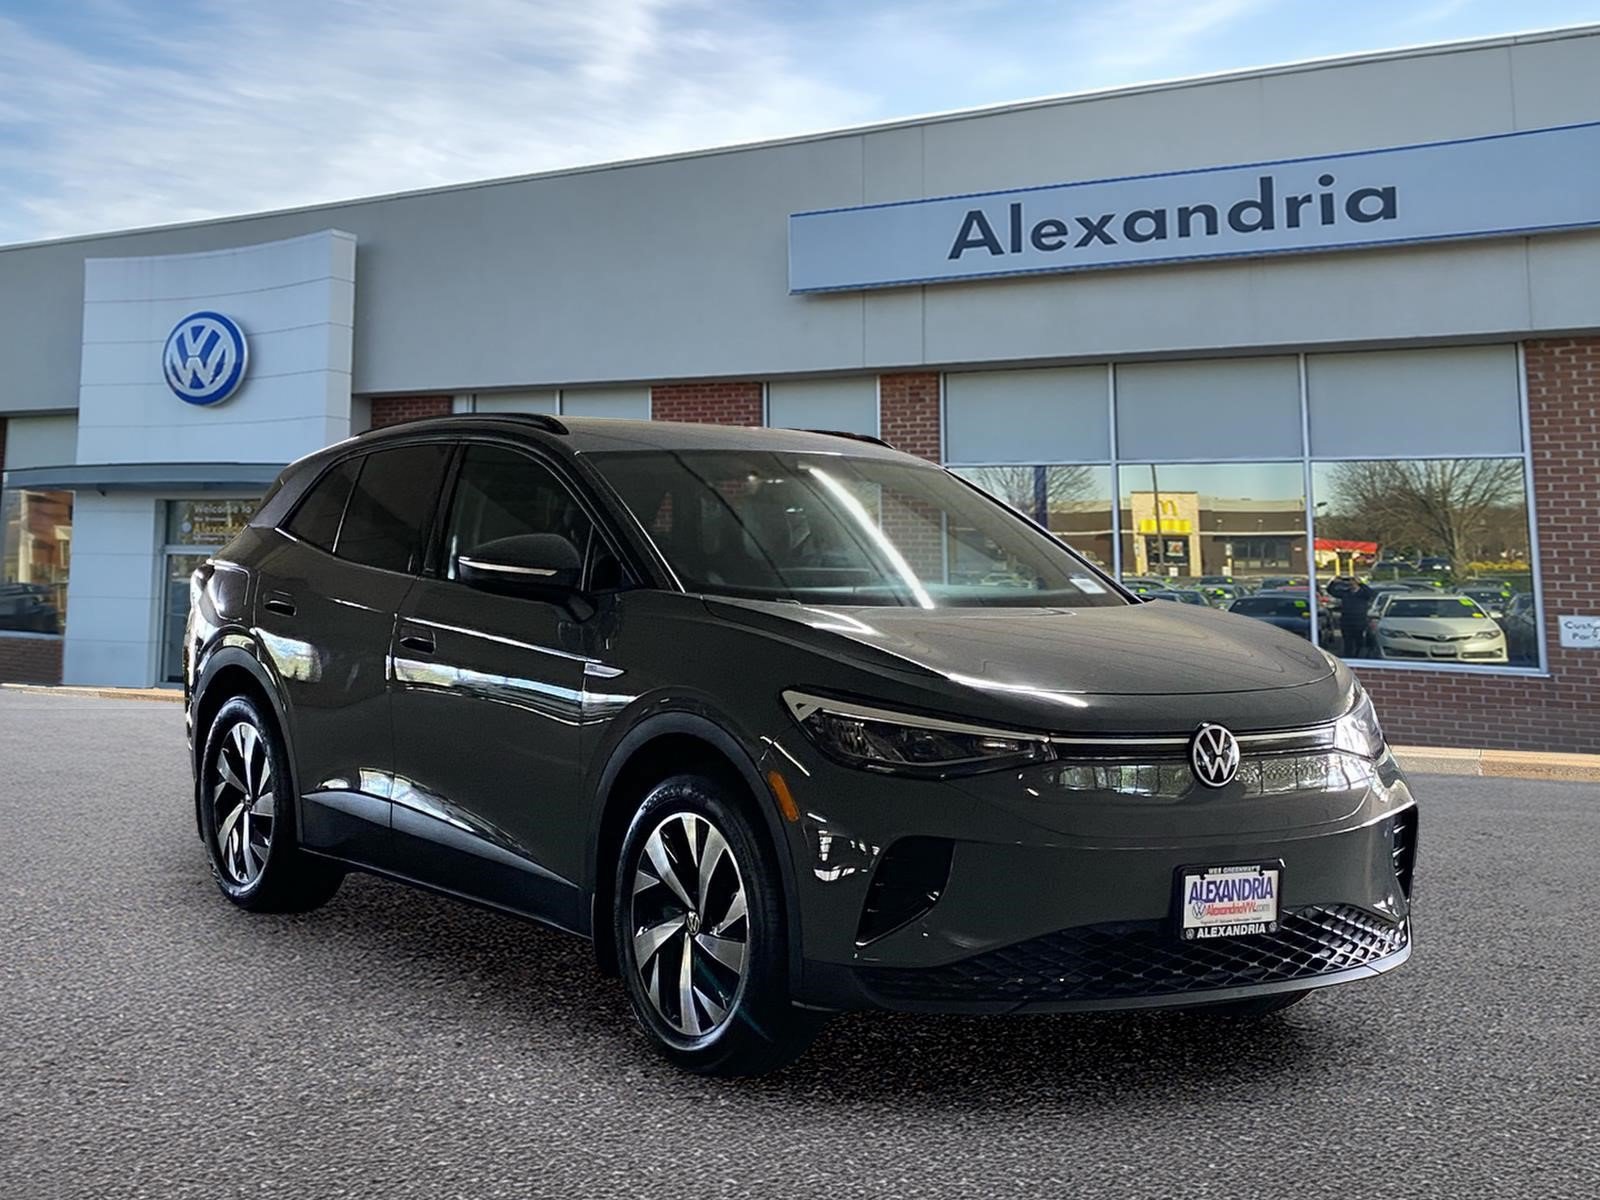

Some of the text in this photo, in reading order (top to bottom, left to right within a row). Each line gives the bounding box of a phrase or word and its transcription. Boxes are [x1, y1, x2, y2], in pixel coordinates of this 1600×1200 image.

[948, 174, 1397, 259] Alexandria
[164, 313, 242, 401] VW
[1194, 726, 1239, 785] VW
[1189, 877, 1273, 904] ALEXANDRIA
[1197, 923, 1266, 938] ALEXANDRIA
